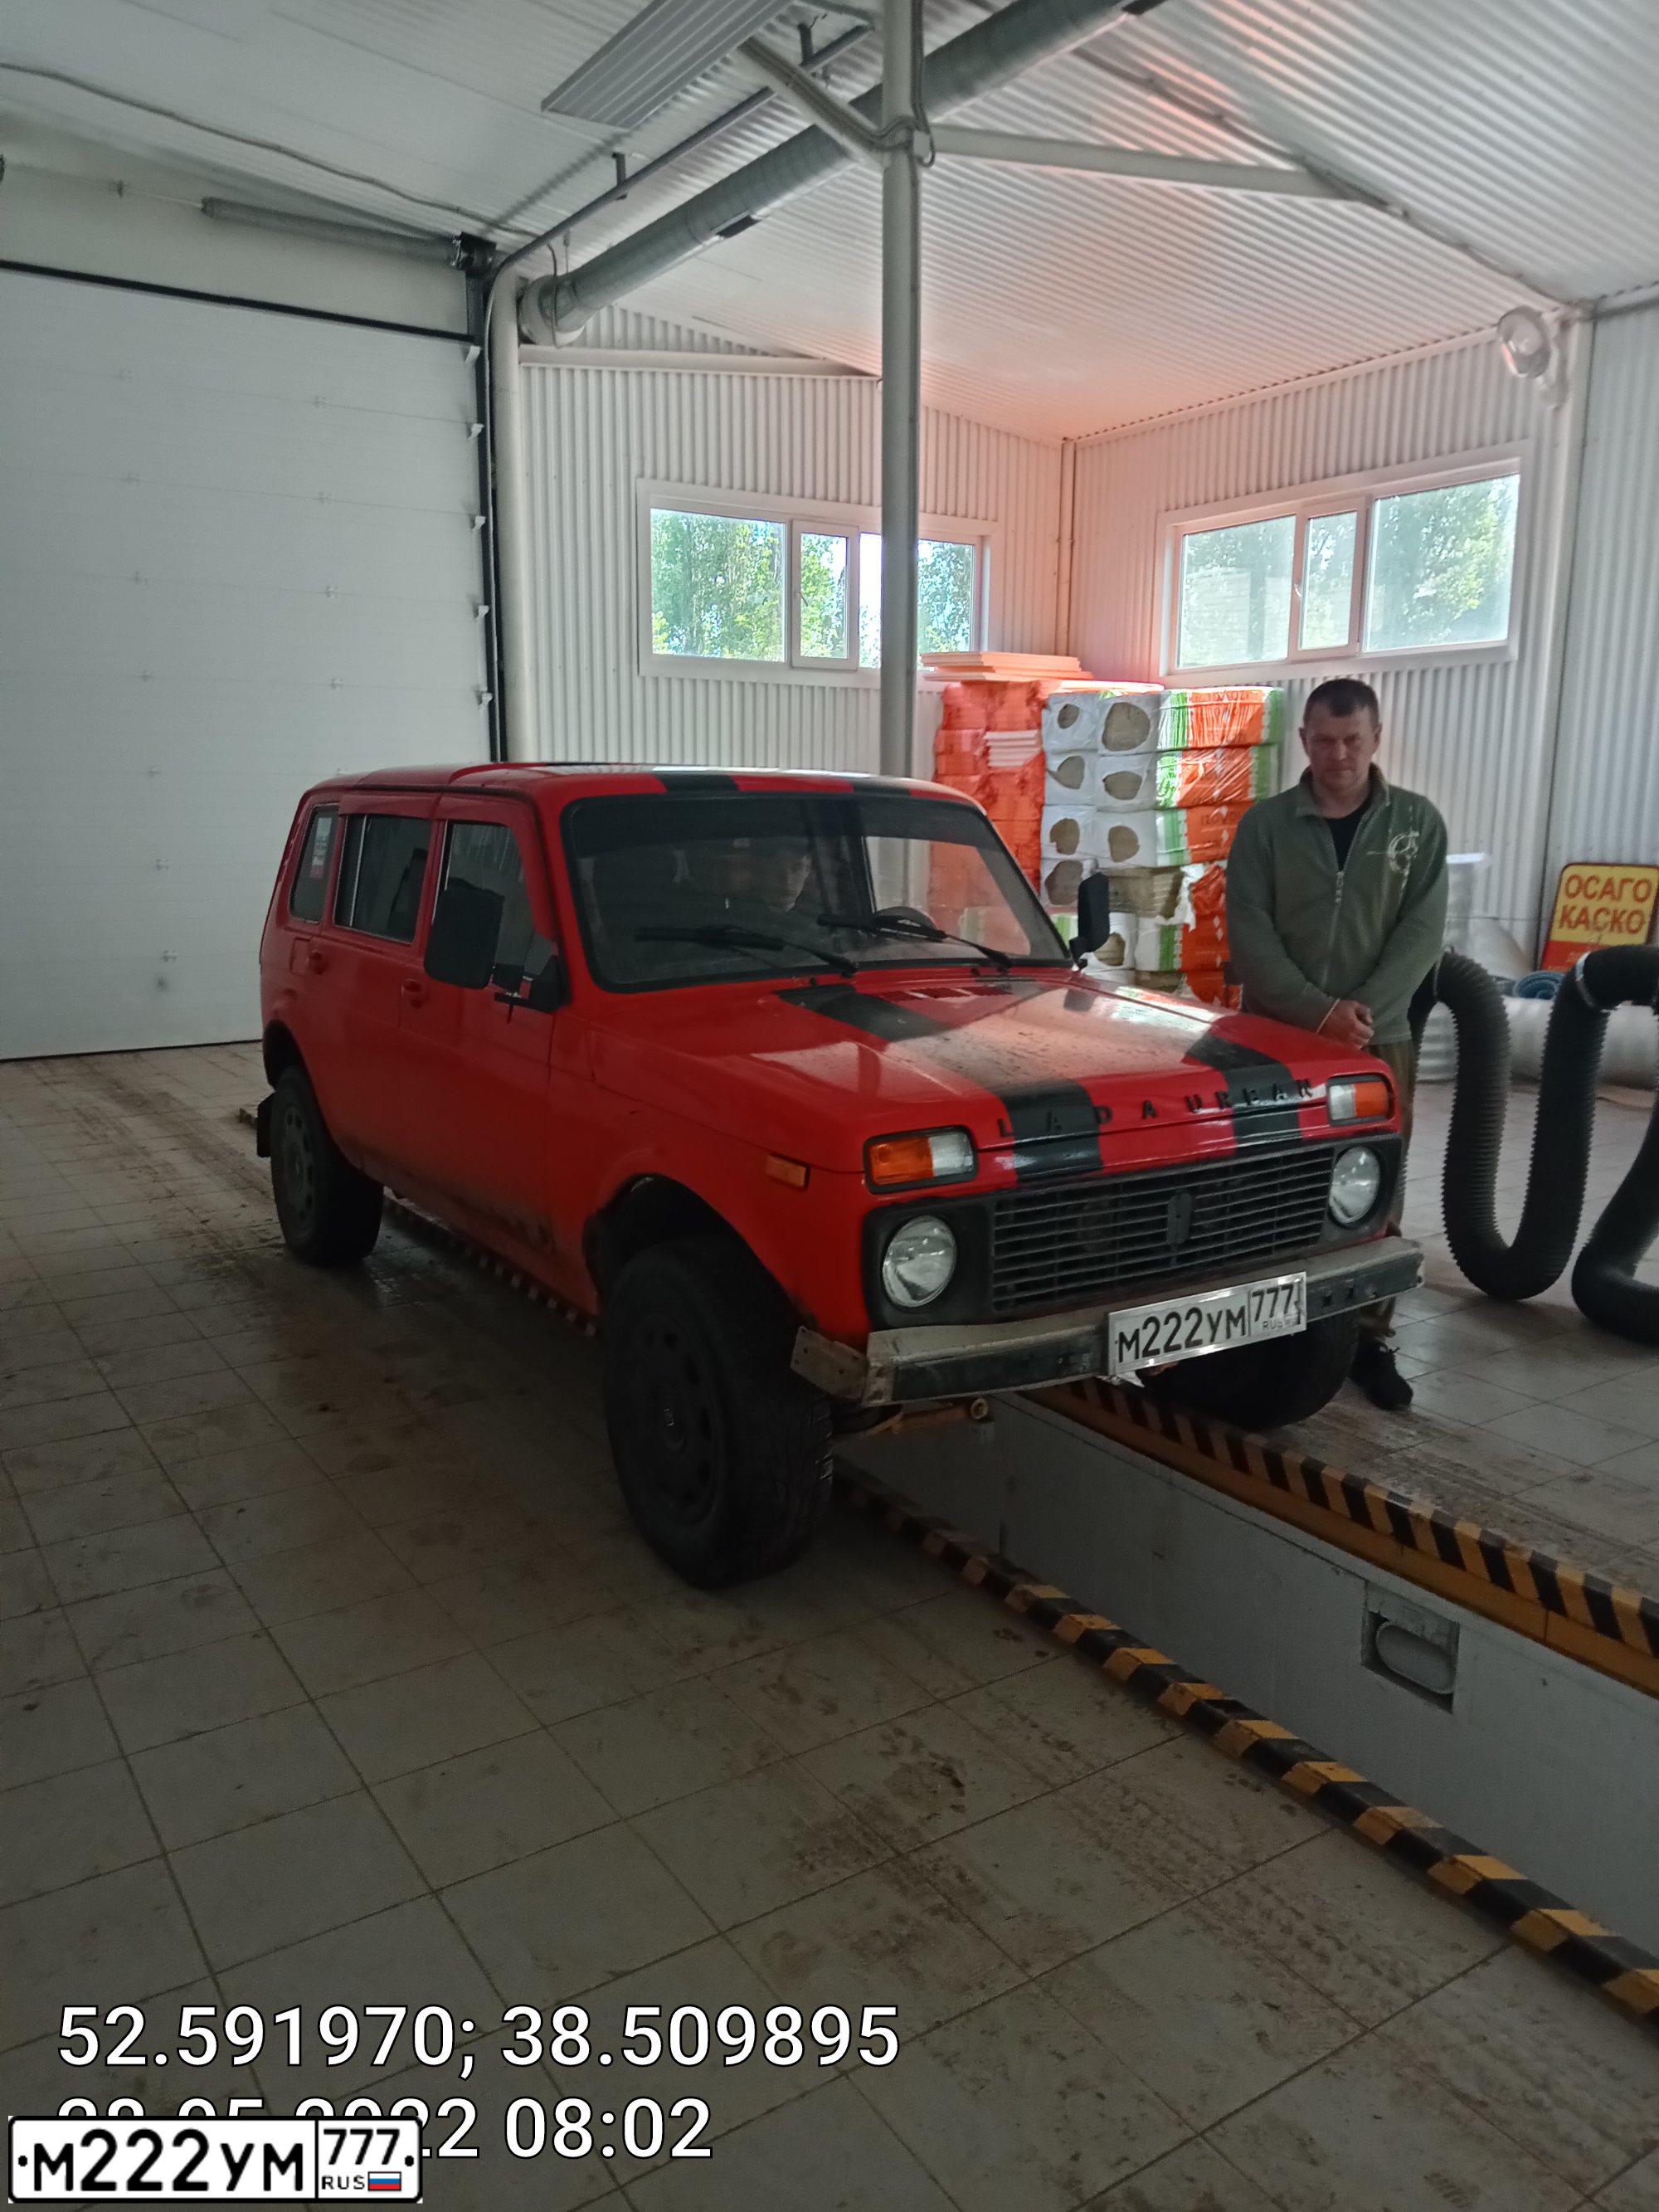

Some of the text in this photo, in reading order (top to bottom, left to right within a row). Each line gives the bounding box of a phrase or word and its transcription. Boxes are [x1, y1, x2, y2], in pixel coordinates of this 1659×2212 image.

[1564, 875, 1652, 904] ОСАГО
[1557, 904, 1646, 935] КАСКО
[1118, 1284, 1294, 1363] М222УМ 777
